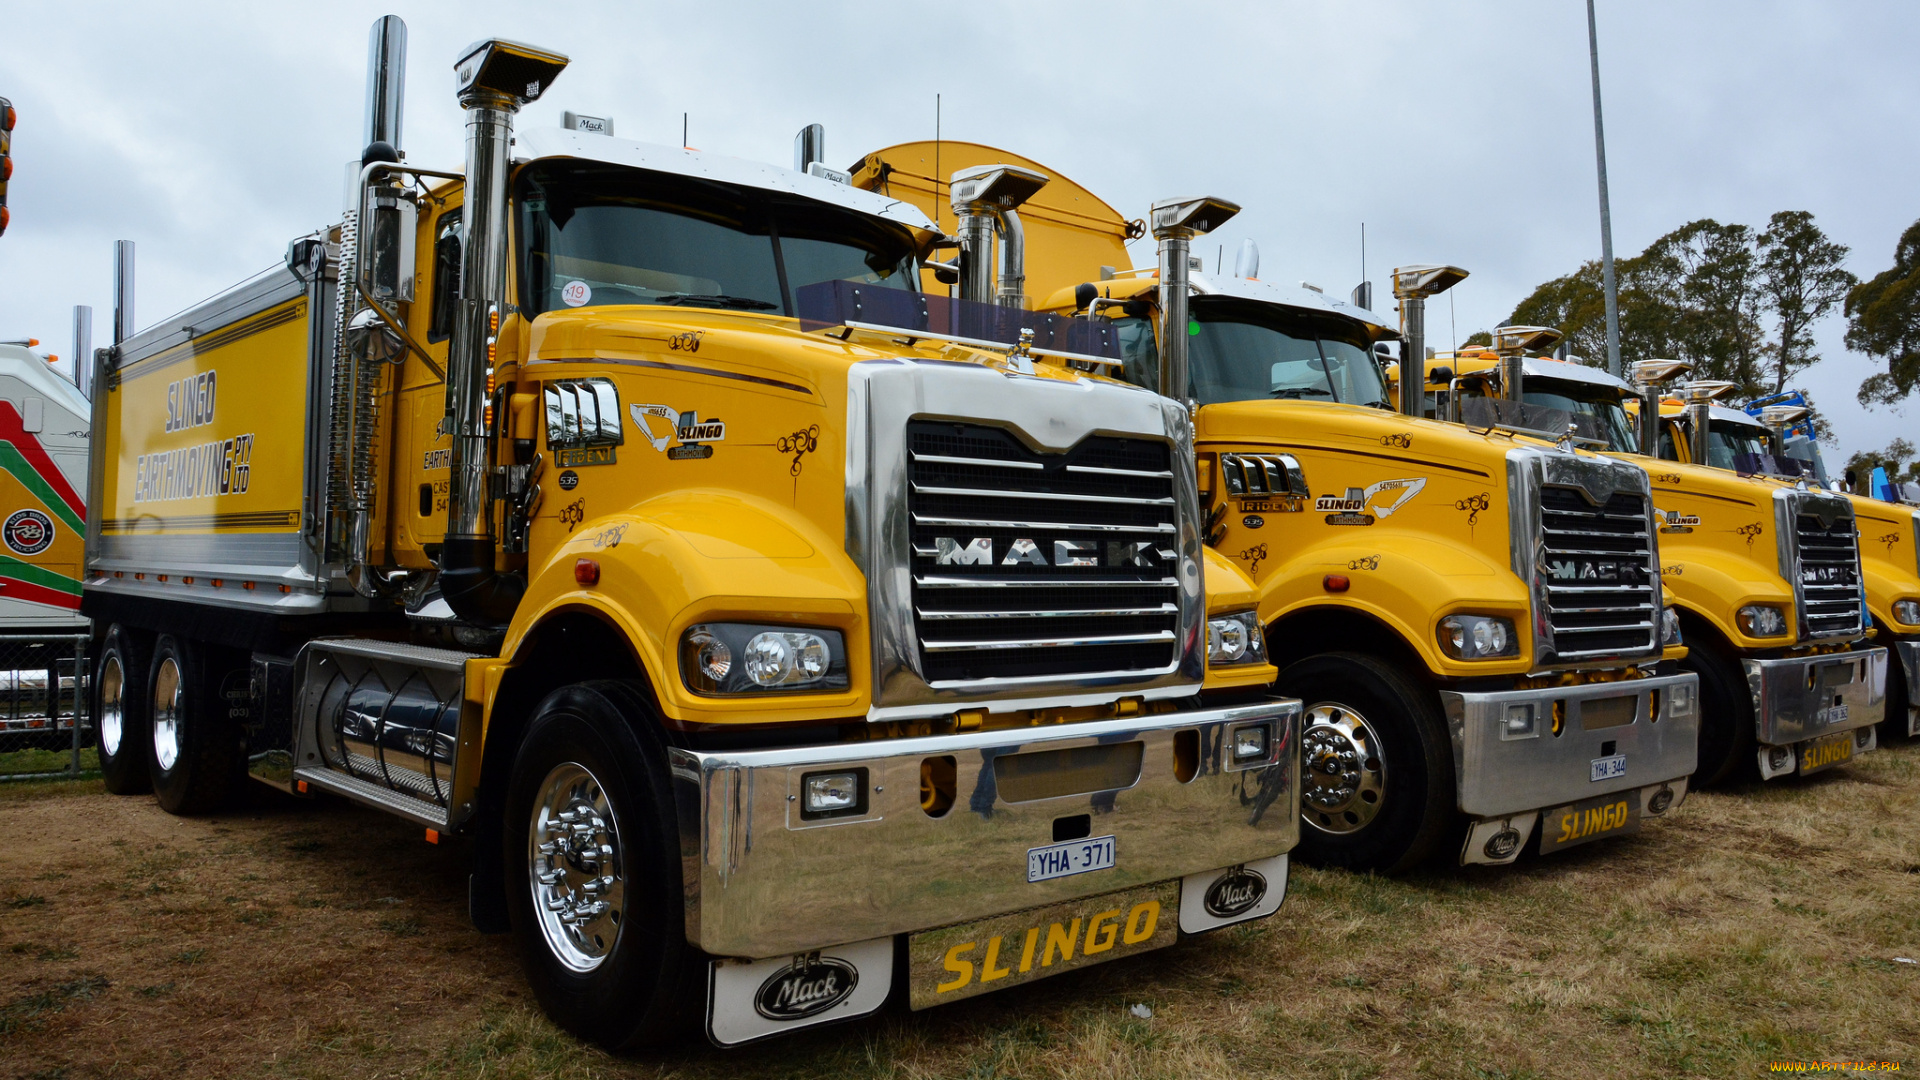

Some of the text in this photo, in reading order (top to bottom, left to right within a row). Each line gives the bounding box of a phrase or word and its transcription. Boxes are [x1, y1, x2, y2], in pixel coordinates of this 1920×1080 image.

[579, 119, 604, 131] Mack
[824, 172, 844, 184] Mack
[165, 369, 217, 434] SLINGO
[679, 424, 723, 440] SLINGO
[134, 433, 255, 503] EARTHMOVING PTY
[232, 464, 251, 495] LTD
[559, 476, 578, 485] 535
[1317, 500, 1362, 511] SLINGO
[29, 512, 49, 525] BROS
[1243, 518, 1264, 526] 535
[10, 540, 48, 552] TRUCKING
[935, 537, 1155, 567] MACK
[1552, 560, 1640, 580] MACK
[1804, 567, 1851, 581] MACK
[1803, 740, 1852, 770] SLINGO
[1556, 801, 1628, 843] SLINGO
[1215, 881, 1255, 908] Mack
[936, 900, 1161, 994] SLINGO
[772, 969, 840, 1010] Mack
